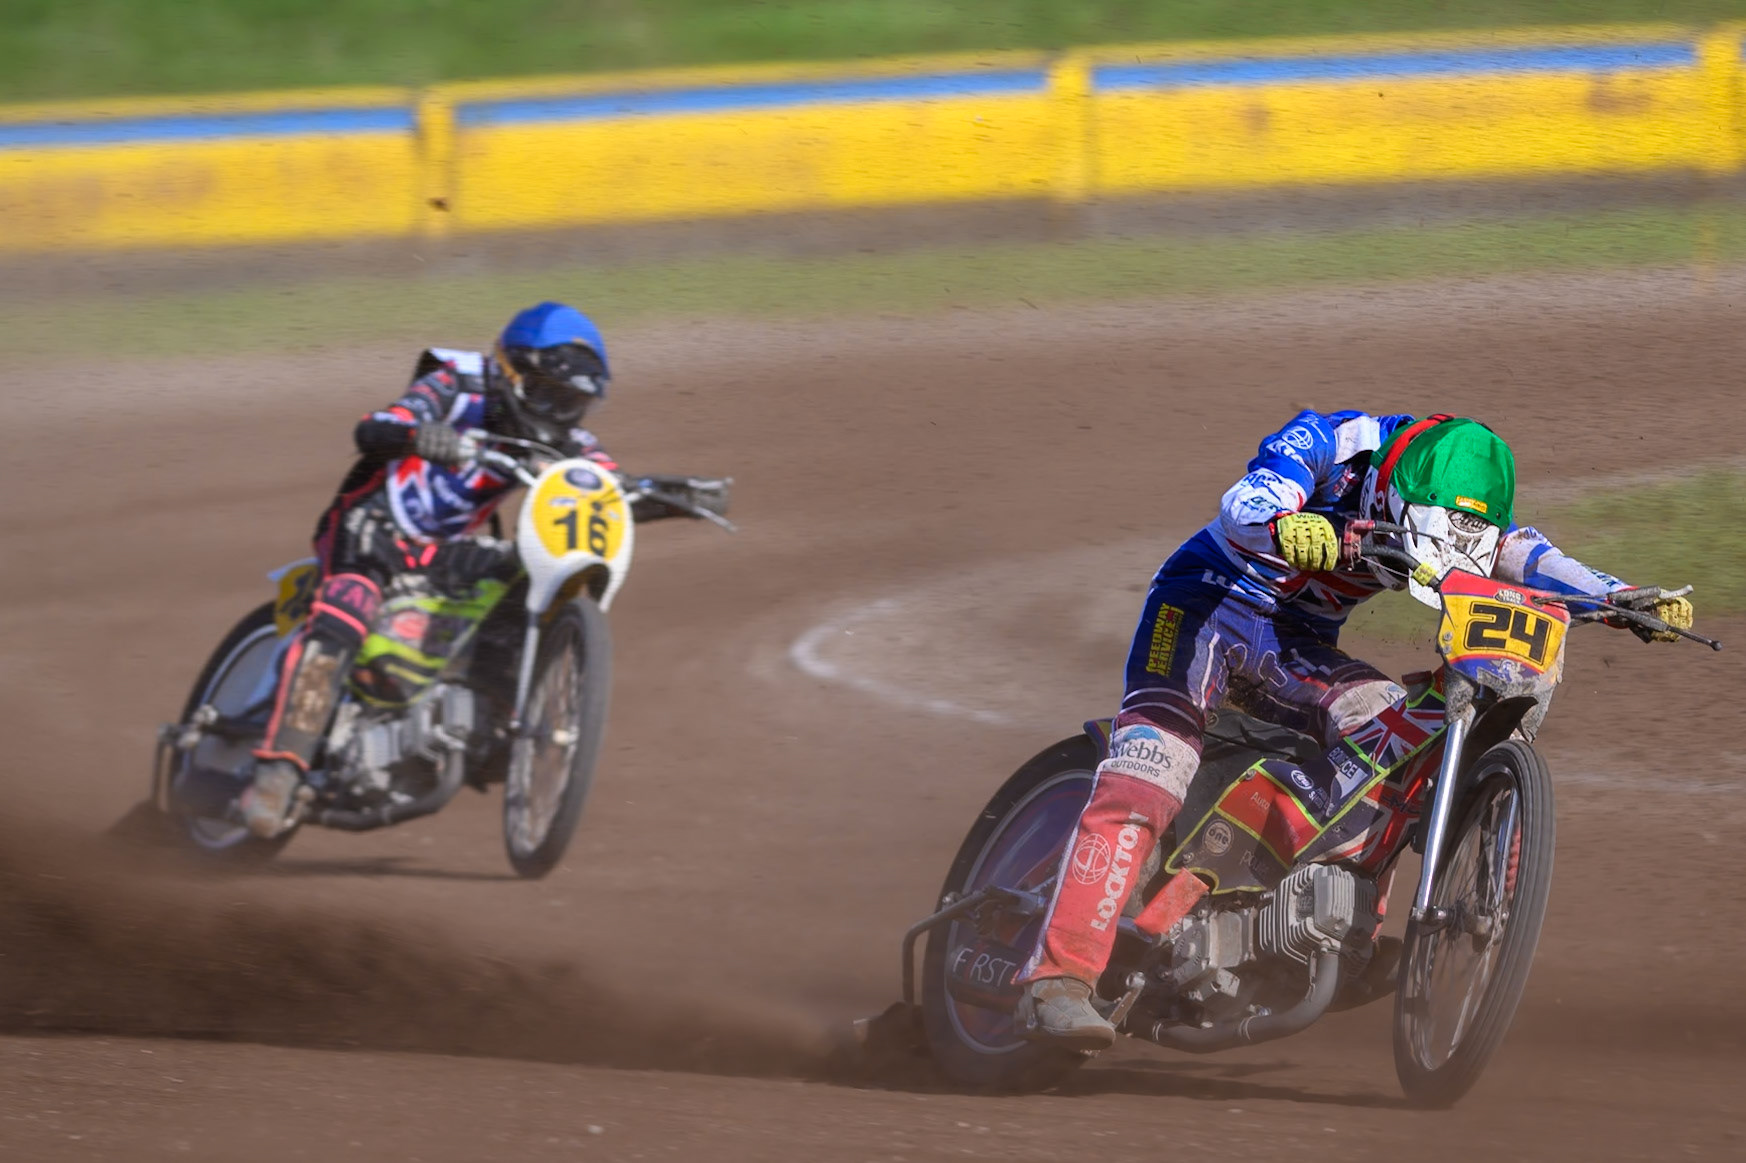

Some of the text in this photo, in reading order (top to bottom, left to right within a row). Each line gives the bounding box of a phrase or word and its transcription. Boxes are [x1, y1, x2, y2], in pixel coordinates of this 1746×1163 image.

[552, 510, 609, 557] 16
[1467, 603, 1549, 663] 24
[1110, 760, 1161, 778] OUTDOORS
[1090, 811, 1149, 931] LOCKTON
